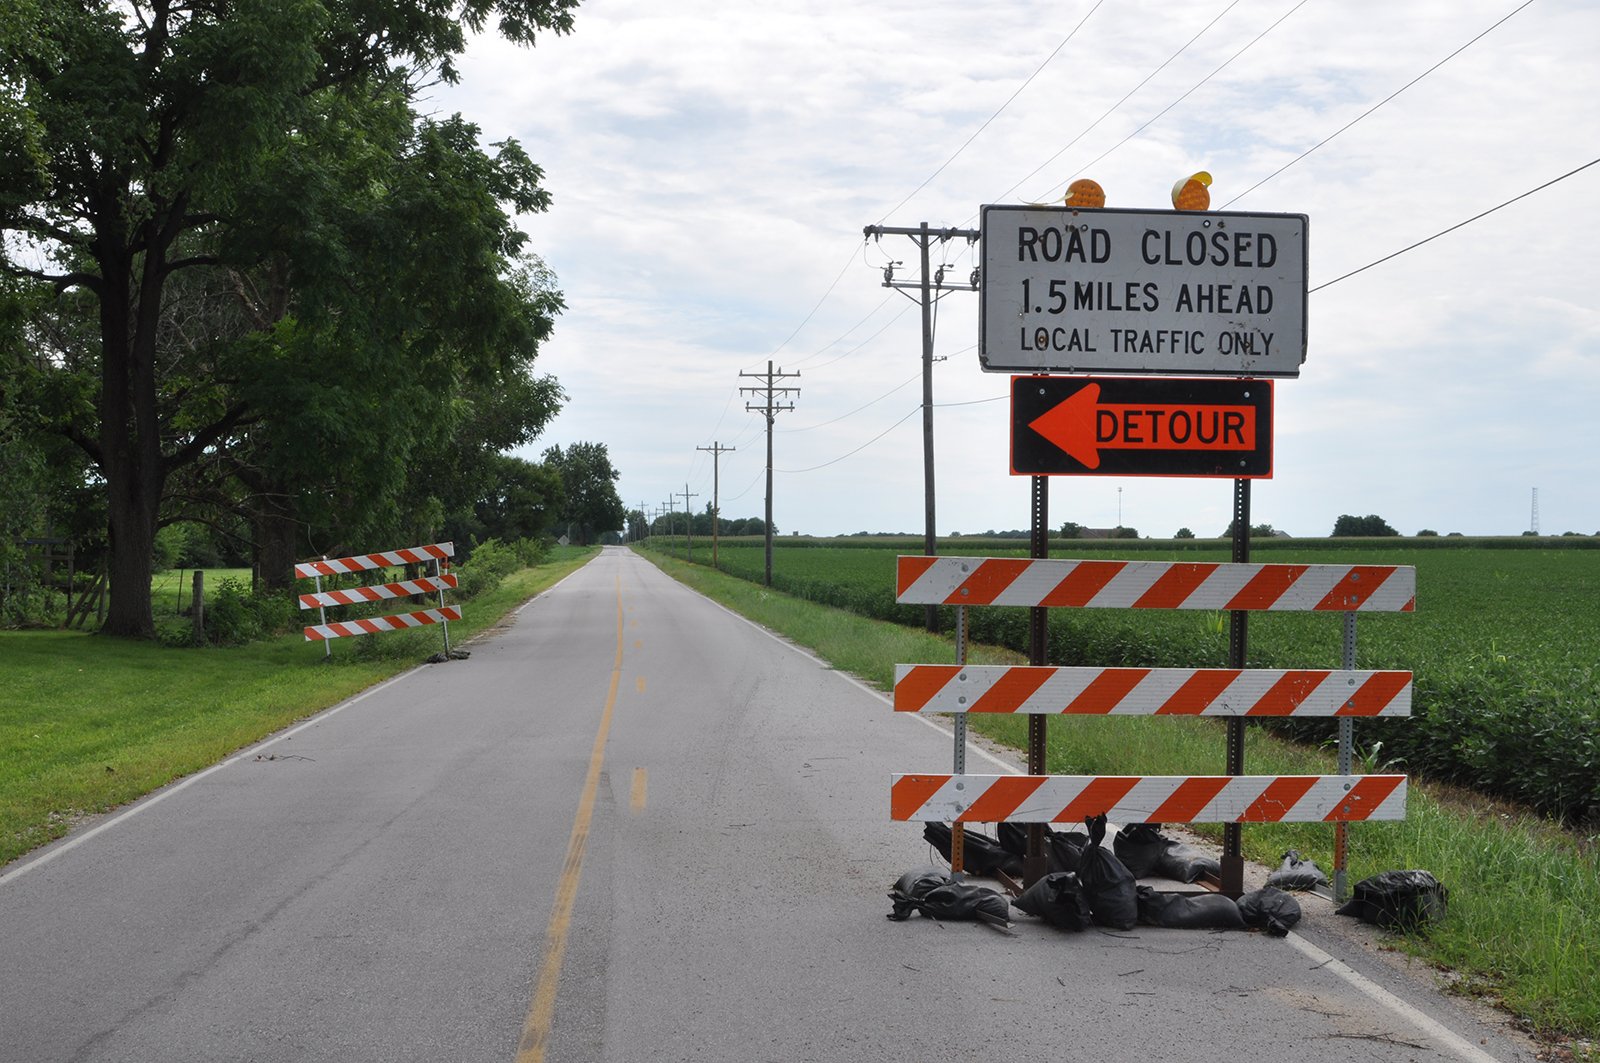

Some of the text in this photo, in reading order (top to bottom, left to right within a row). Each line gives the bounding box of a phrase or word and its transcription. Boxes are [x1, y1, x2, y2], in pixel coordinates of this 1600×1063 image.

[1018, 226, 1278, 268] ROAD CLOSED
[1022, 278, 1274, 315] 1.5 MILES AHEAD
[1020, 326, 1275, 356] LOCAL TRAFFIC ONLY
[1096, 409, 1246, 445] DETOUR
